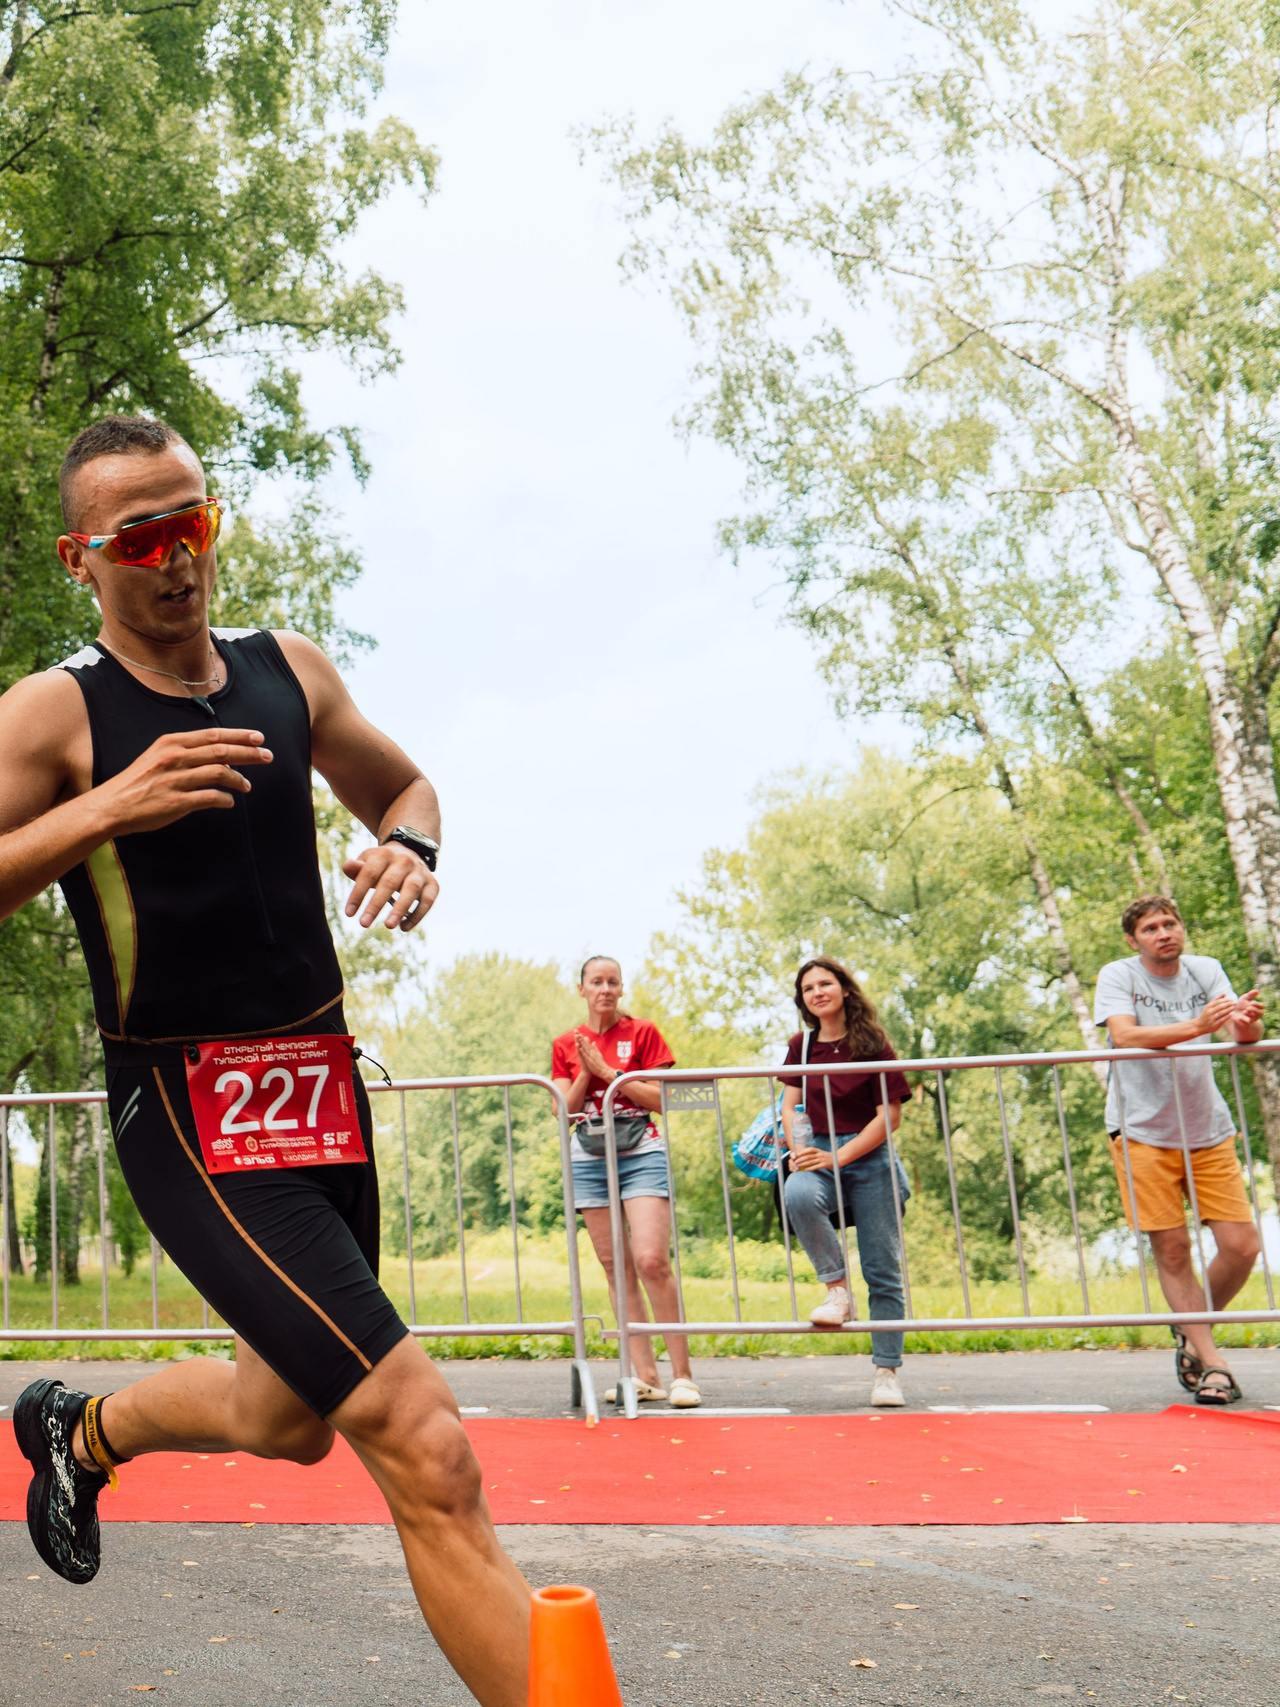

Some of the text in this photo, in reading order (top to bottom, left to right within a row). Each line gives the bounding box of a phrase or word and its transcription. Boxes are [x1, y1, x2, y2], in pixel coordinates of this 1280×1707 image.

[224, 1041, 319, 1055] ОТКРЫТЫЙ ЧЕМПИОНАТ
[213, 1053, 260, 1065] ТУЛЬСКОЙ
[300, 1050, 329, 1059] СПРИНТ
[214, 1064, 330, 1135] 227
[243, 1156, 276, 1166] ЭЛЬФ
[88, 1405, 97, 1447] LIMETIME
